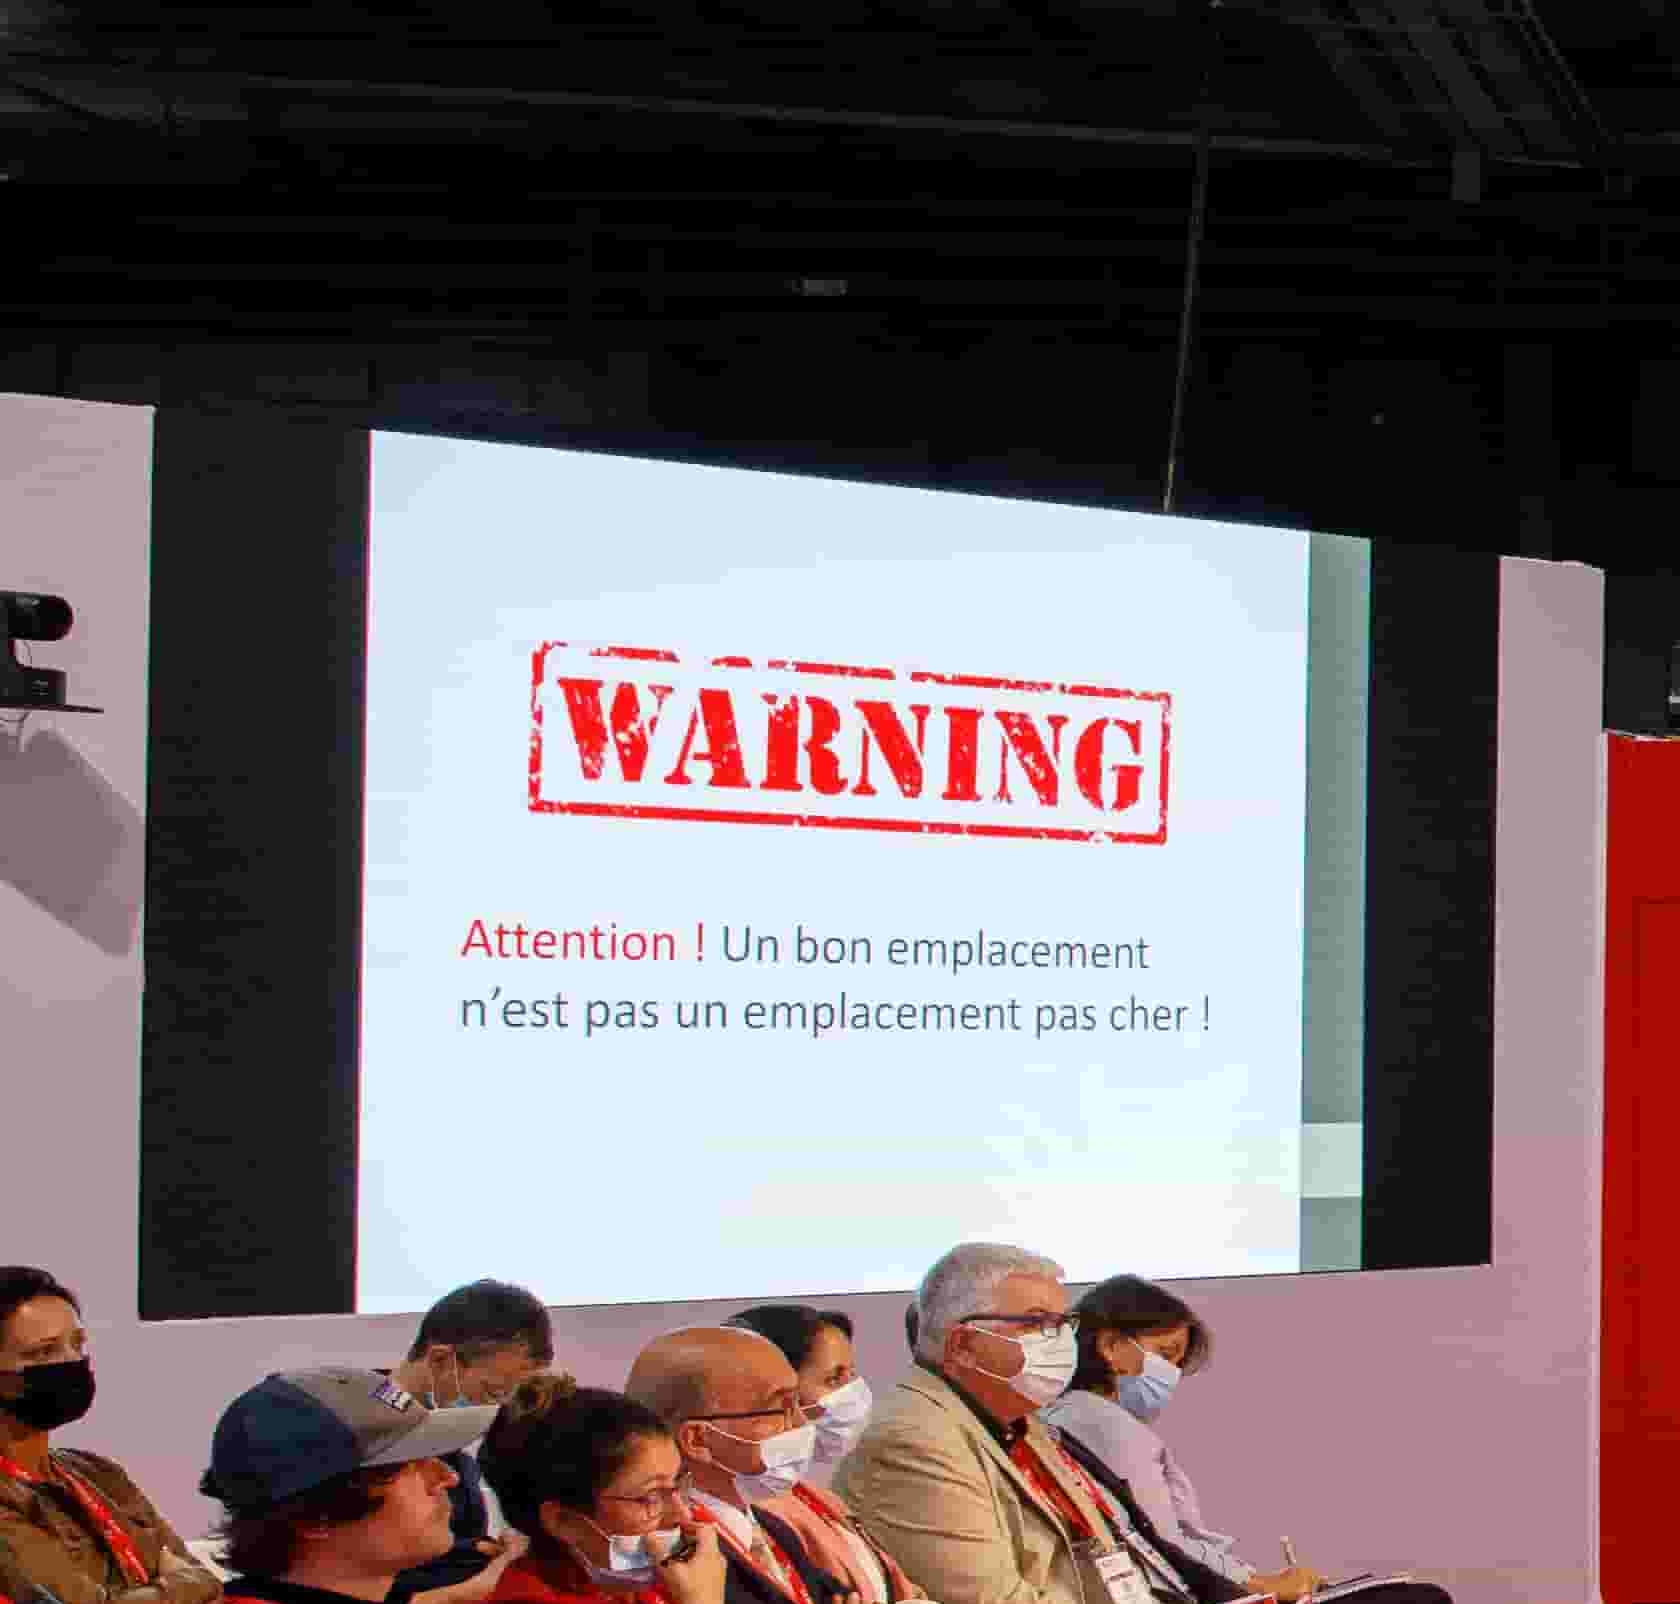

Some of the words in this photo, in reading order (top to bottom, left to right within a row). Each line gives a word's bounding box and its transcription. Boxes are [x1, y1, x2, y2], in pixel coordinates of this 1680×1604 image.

[558, 676, 1148, 813] WARNING
[461, 918, 677, 961] Attention
[722, 925, 779, 964] Un
[797, 923, 872, 966] bon
[887, 928, 1150, 976] emplacement
[461, 985, 569, 1029] n'est
[585, 998, 659, 1038] pas
[676, 1000, 727, 1030] un
[743, 991, 1022, 1039] emplacement
[1034, 1003, 1097, 1041] pas
[1109, 993, 1187, 1032] cher
